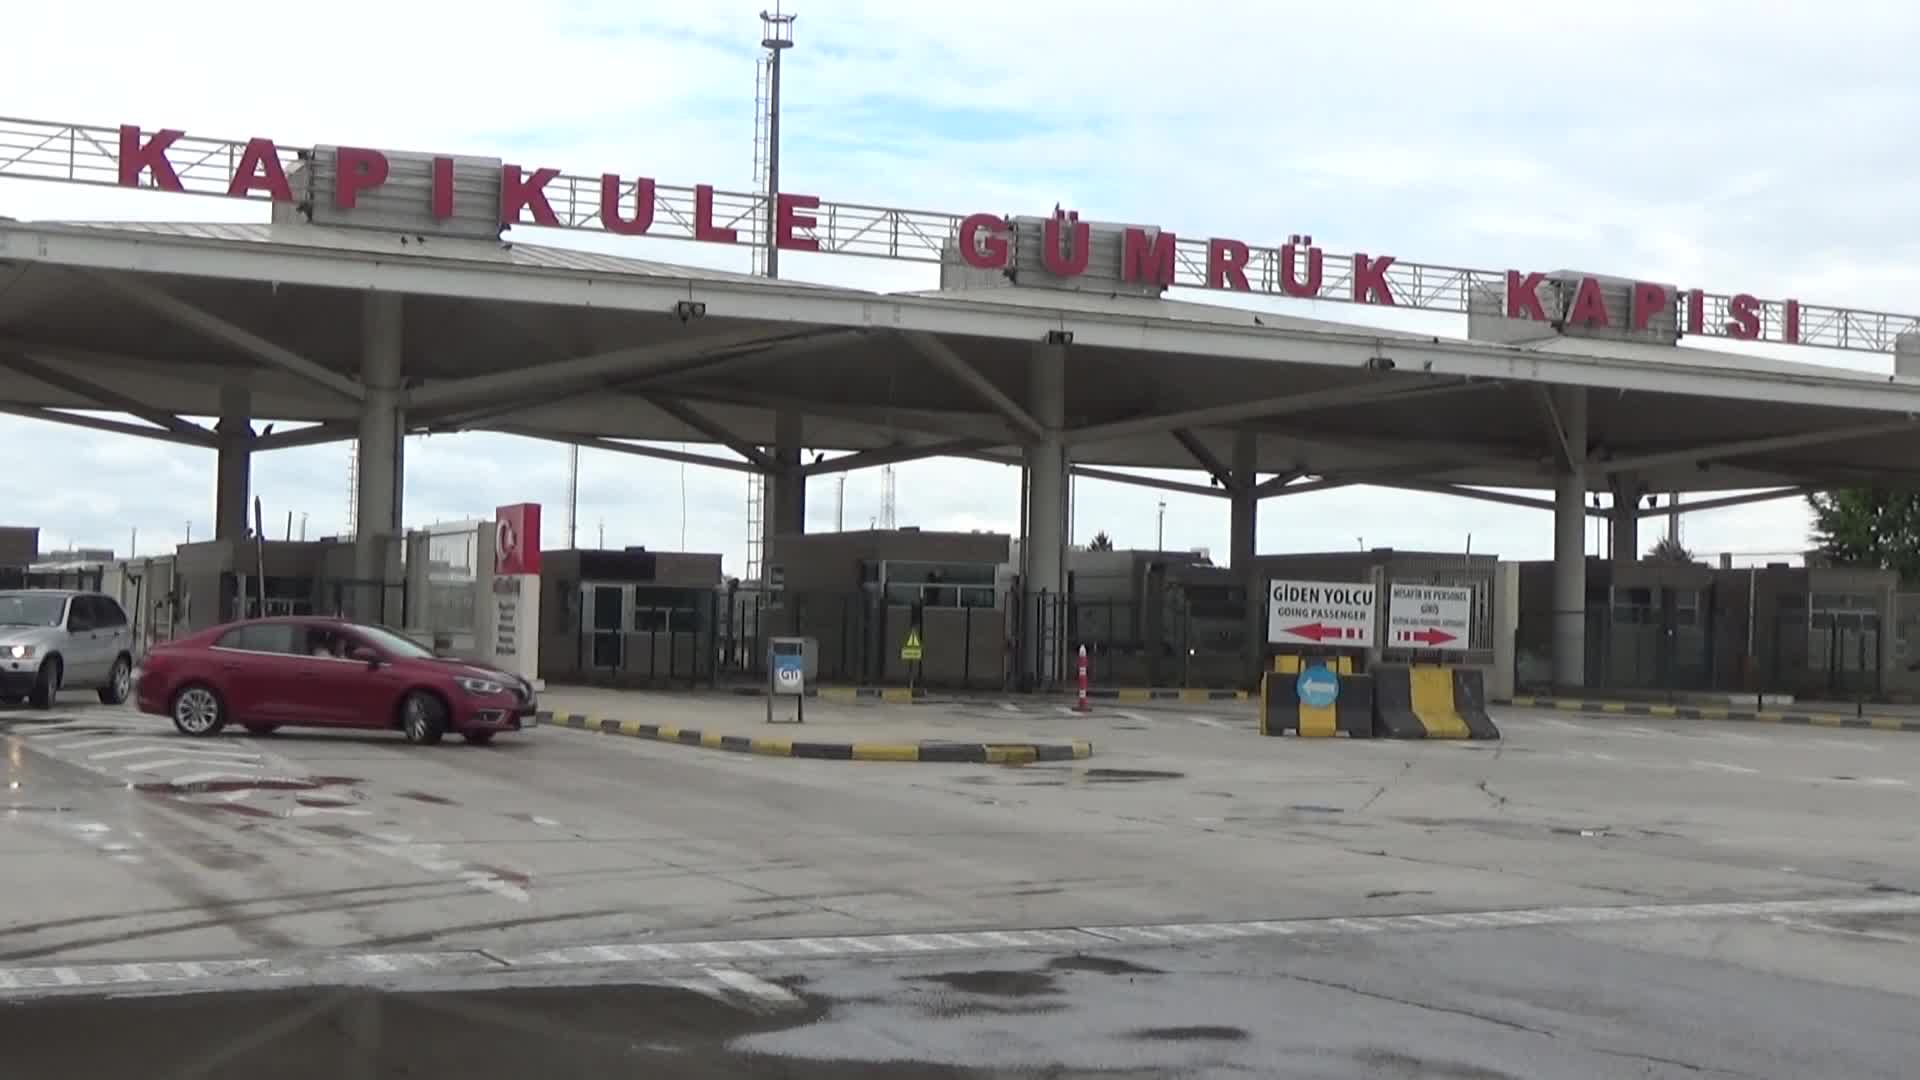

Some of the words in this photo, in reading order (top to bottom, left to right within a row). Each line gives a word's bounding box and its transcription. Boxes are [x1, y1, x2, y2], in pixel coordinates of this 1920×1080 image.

[118, 123, 820, 252] KAPIKULE
[958, 209, 1397, 305] GÜMRÜK
[1505, 269, 1800, 345] KAPISI
[1273, 584, 1320, 603] GİDEN
[1324, 588, 1373, 606] YOLCU
[1278, 607, 1309, 618] GOING
[1311, 608, 1367, 621] PASSENGER
